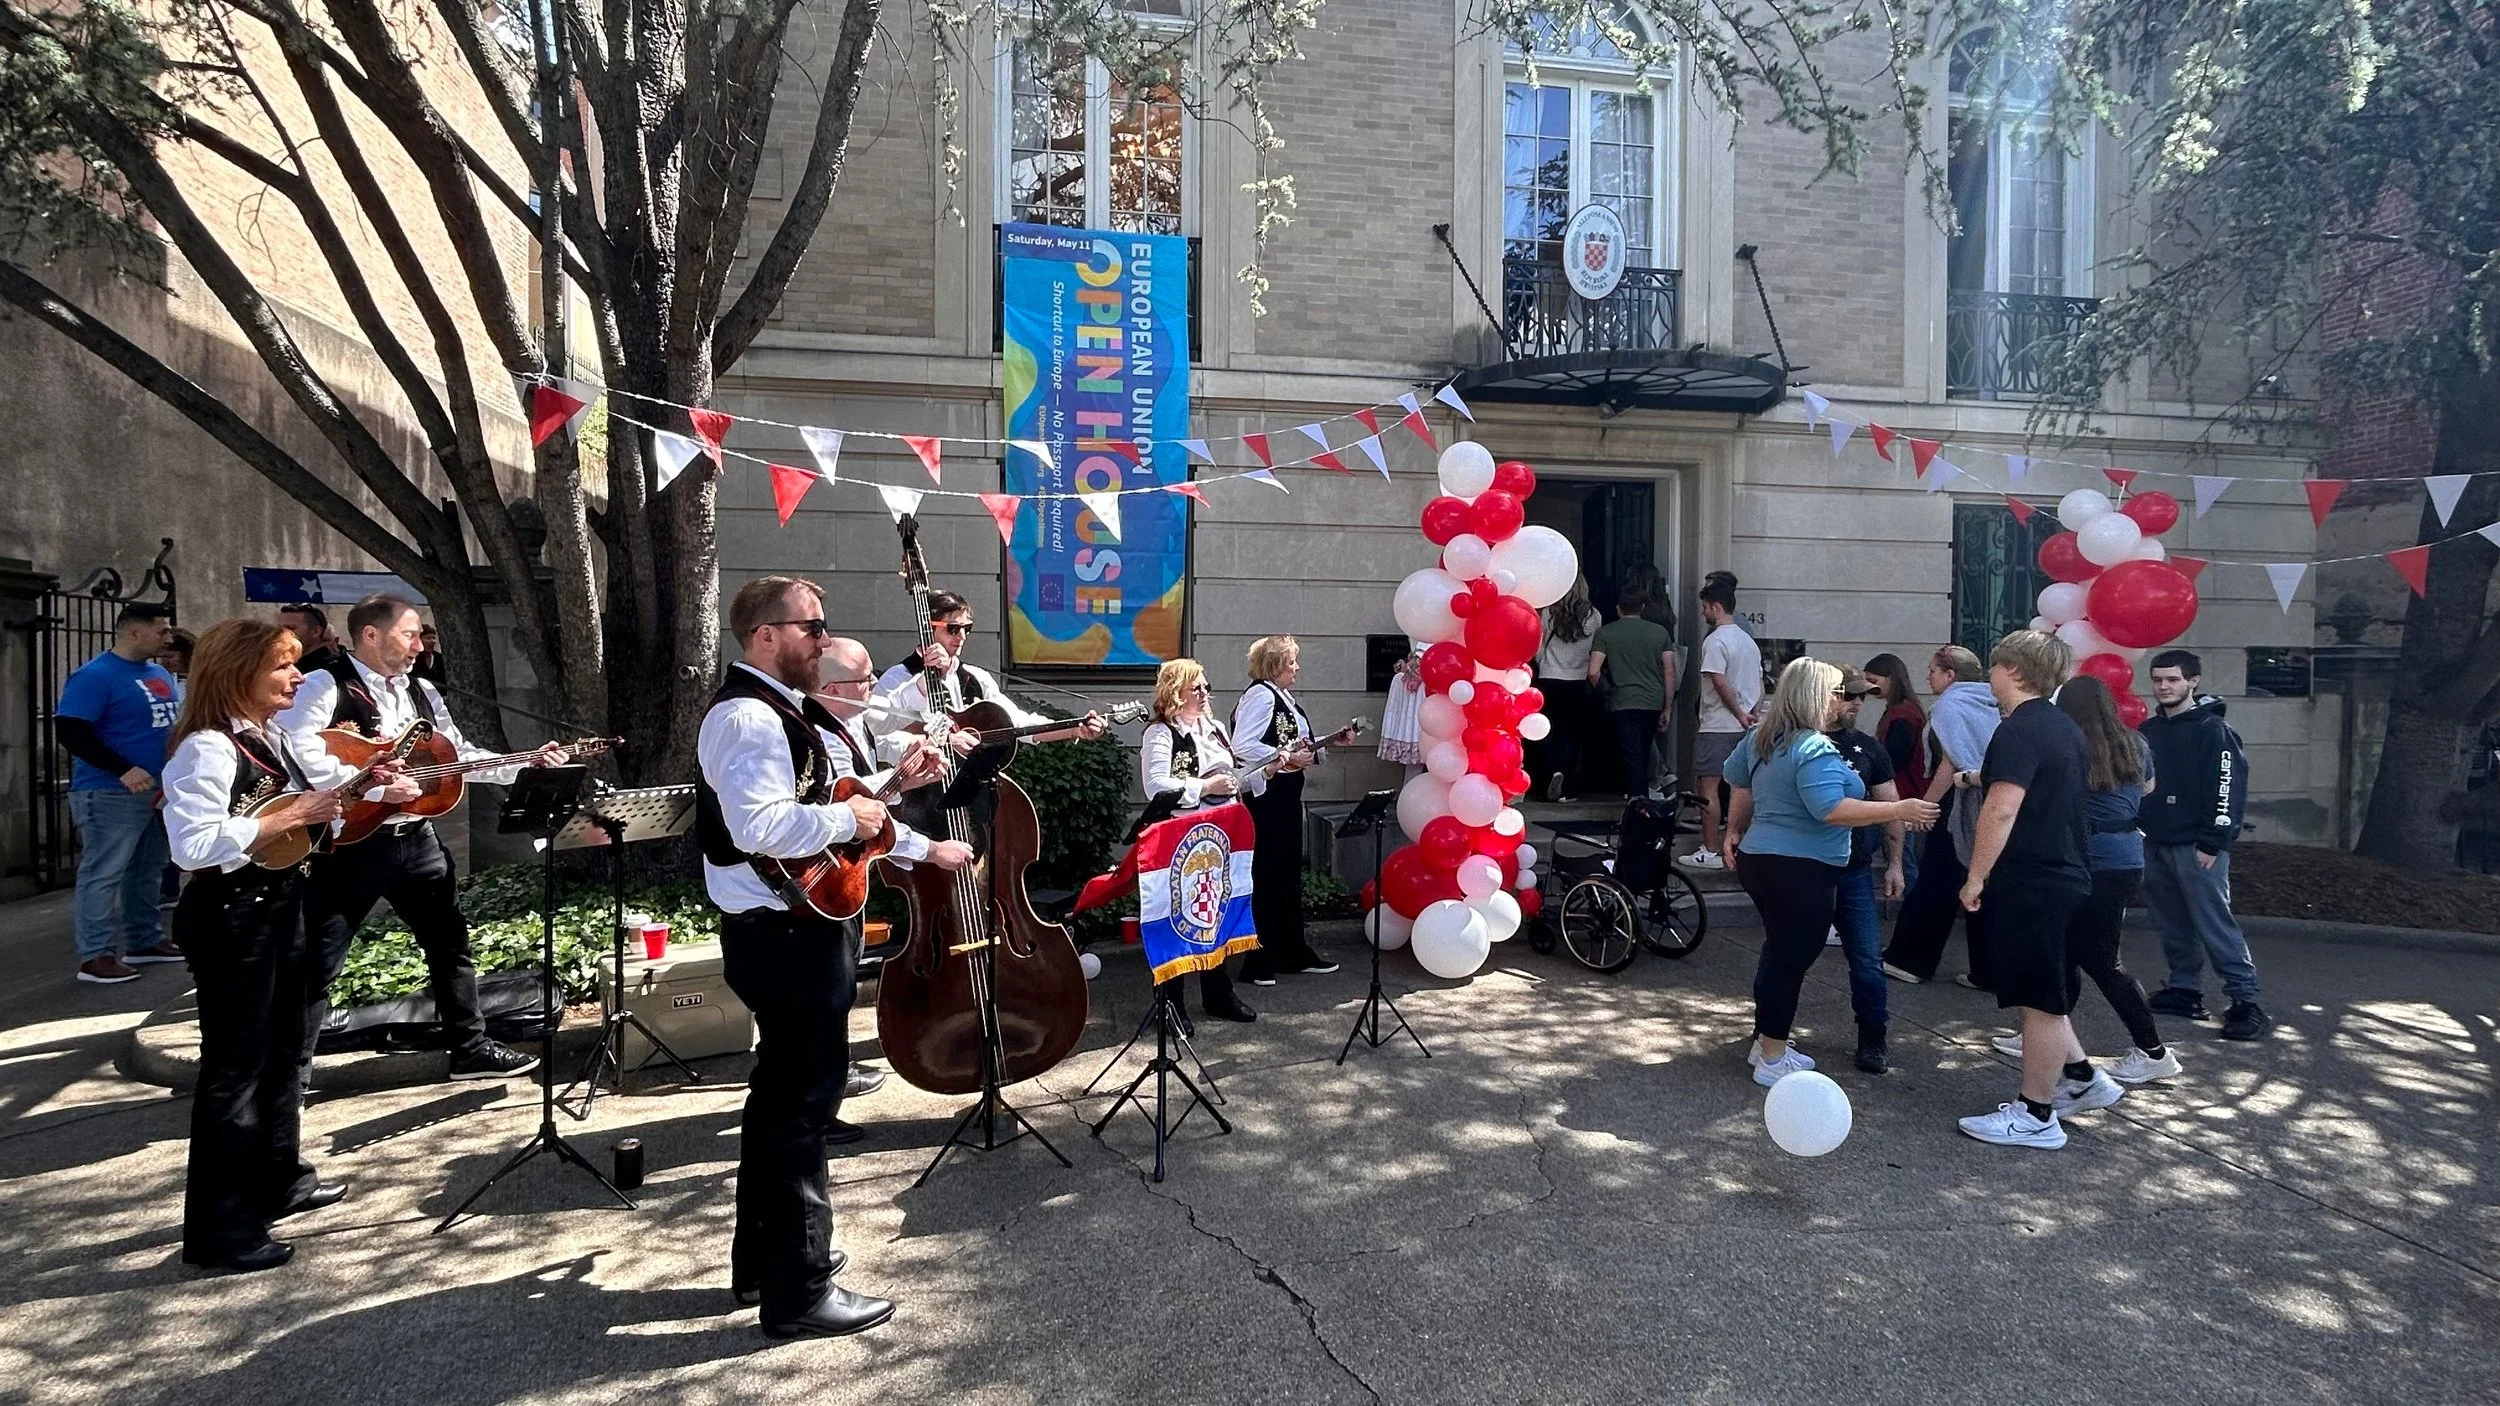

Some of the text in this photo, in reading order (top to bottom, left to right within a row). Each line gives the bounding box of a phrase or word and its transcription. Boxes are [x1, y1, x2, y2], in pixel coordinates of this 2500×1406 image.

[1007, 233, 1091, 250] Saturday, May 11
[1053, 281, 1064, 332] Shortcut
[1053, 334, 1064, 346] to
[1130, 243, 1153, 475] EUROPEAN UNION
[1051, 348, 1064, 390] Europe
[1053, 410, 1065, 428] No
[1074, 240, 1123, 615] OPEN HOUSE
[1053, 432, 1065, 488] Passport
[2217, 751, 2232, 814] carhartt
[1171, 845, 1189, 917] CROATIAN
[1177, 920, 1192, 935] OF
[675, 995, 701, 1005] YETI
